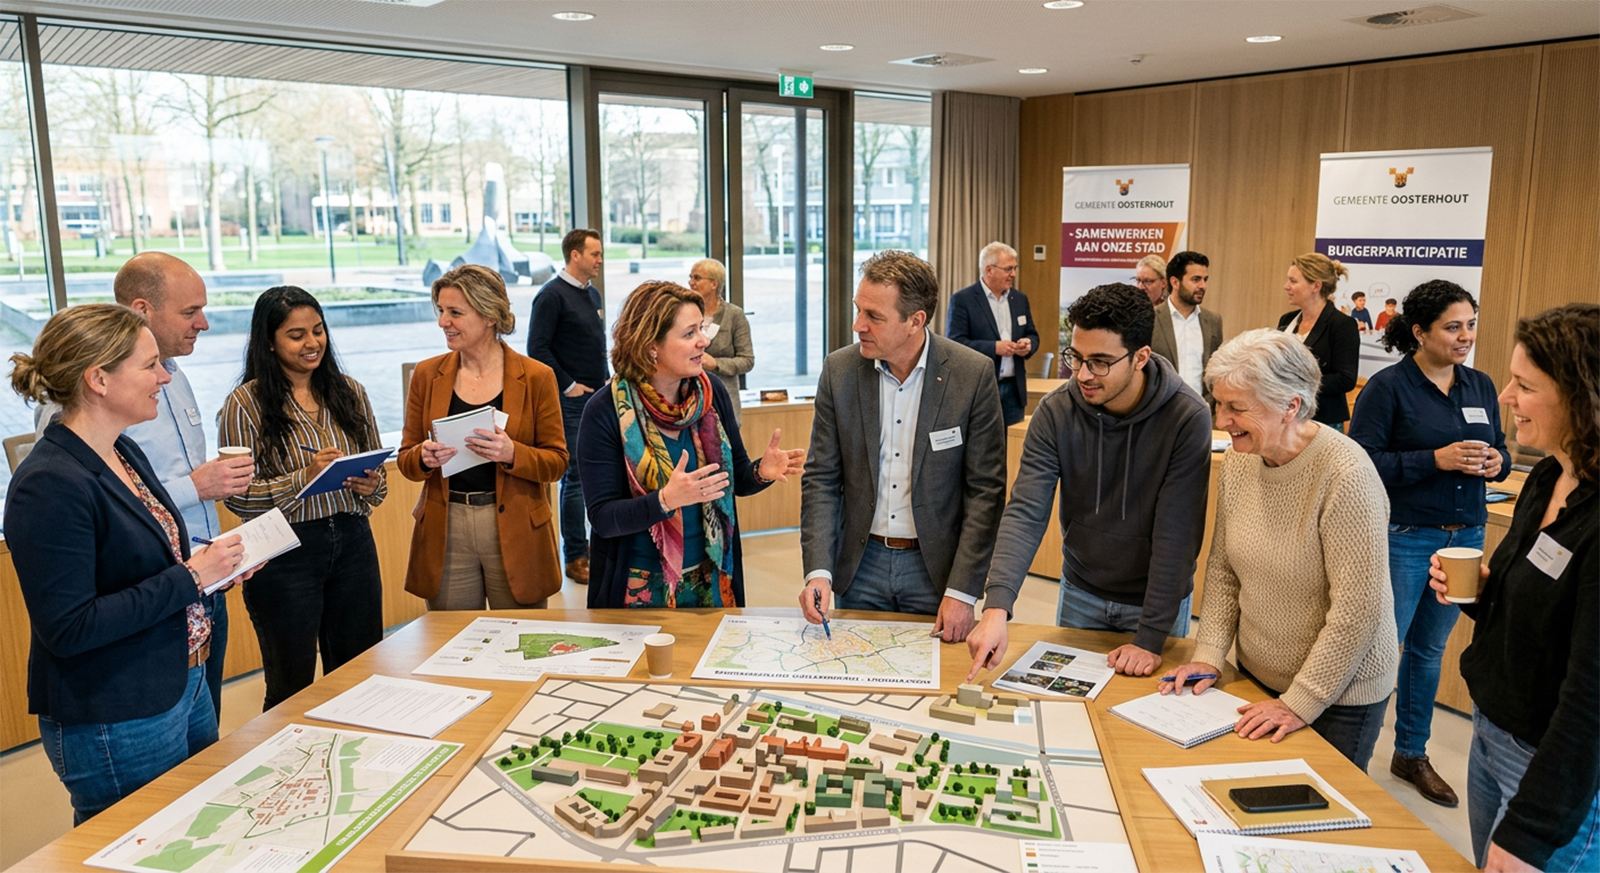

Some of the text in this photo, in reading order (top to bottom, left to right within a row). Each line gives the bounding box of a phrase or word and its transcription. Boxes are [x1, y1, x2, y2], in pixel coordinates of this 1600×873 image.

[1333, 193, 1469, 205] GEMEENTE OOSTERHOUT
[1075, 228, 1164, 240] SAMENWERKEN
[1075, 242, 1166, 254] AAN ONZE STAD
[1327, 244, 1468, 258] BURGERPARTICIPATIE
